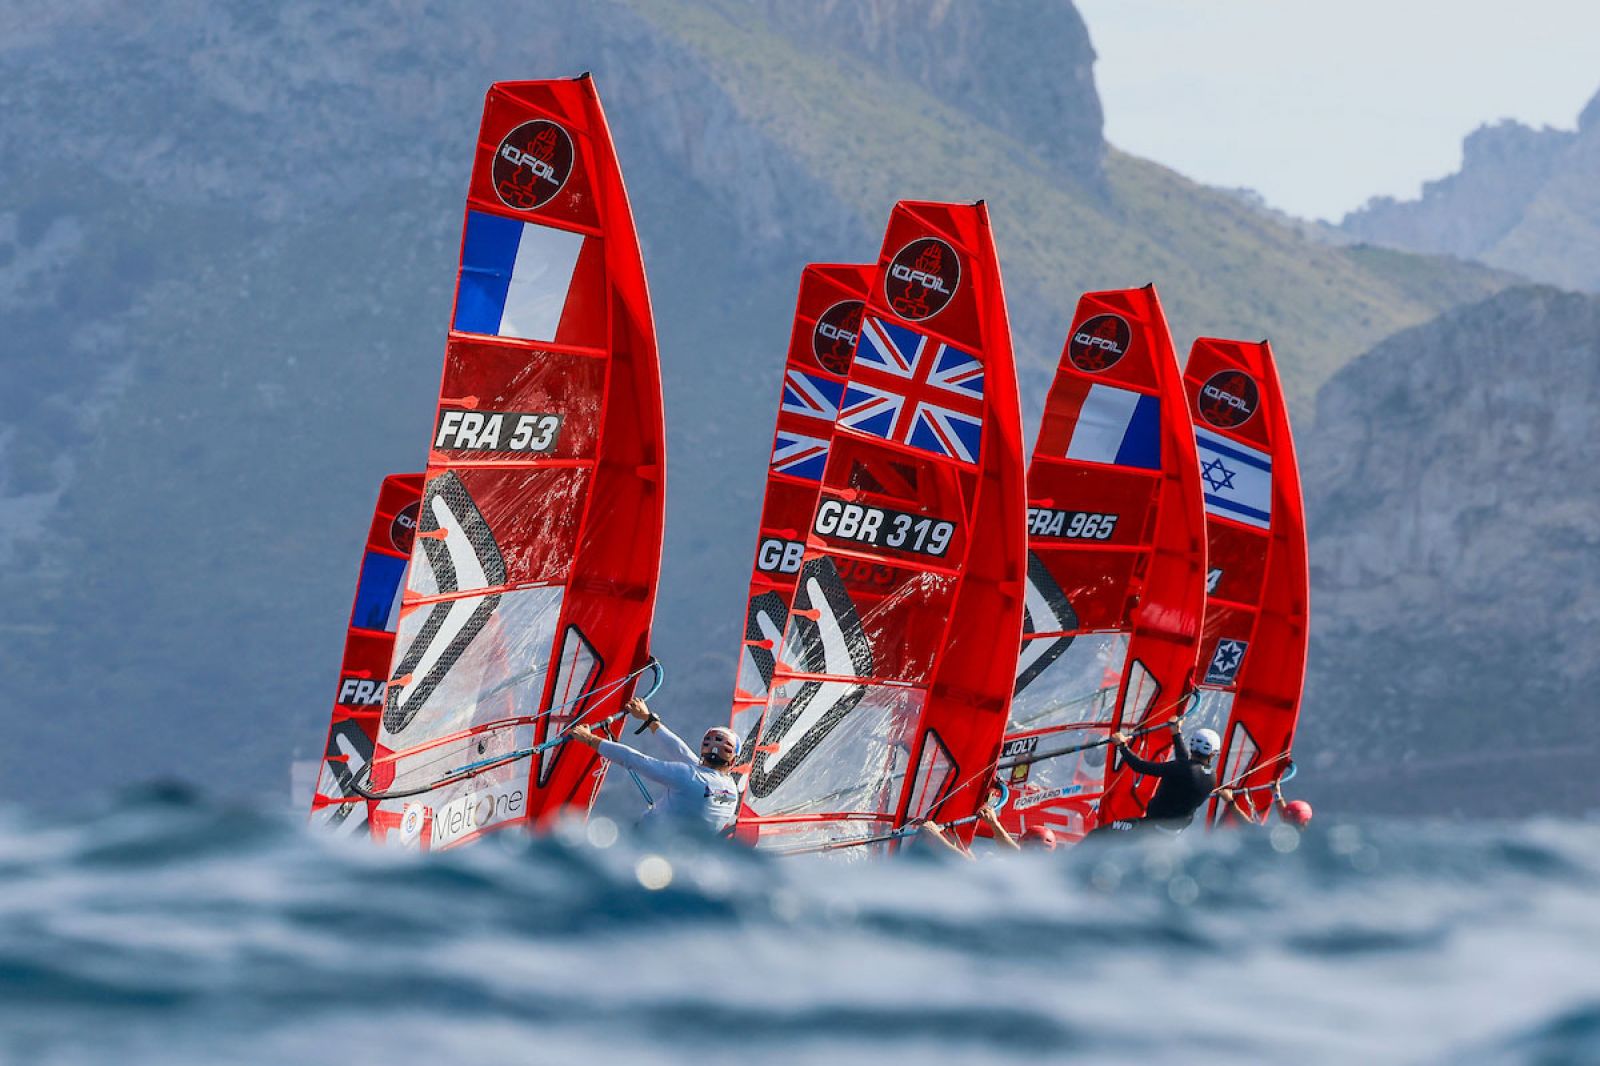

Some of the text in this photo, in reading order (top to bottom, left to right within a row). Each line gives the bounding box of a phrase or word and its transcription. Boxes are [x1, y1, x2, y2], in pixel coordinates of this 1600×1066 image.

[435, 411, 559, 451] FRA 53
[815, 500, 954, 555] GBR 319
[1028, 508, 1118, 539] FRA 965
[338, 679, 387, 705] FRA
[1006, 737, 1037, 755] JOLY
[1015, 784, 1082, 807] FORWARD WIP
[432, 789, 524, 844] MeltOne
[1112, 820, 1133, 831] WIP
